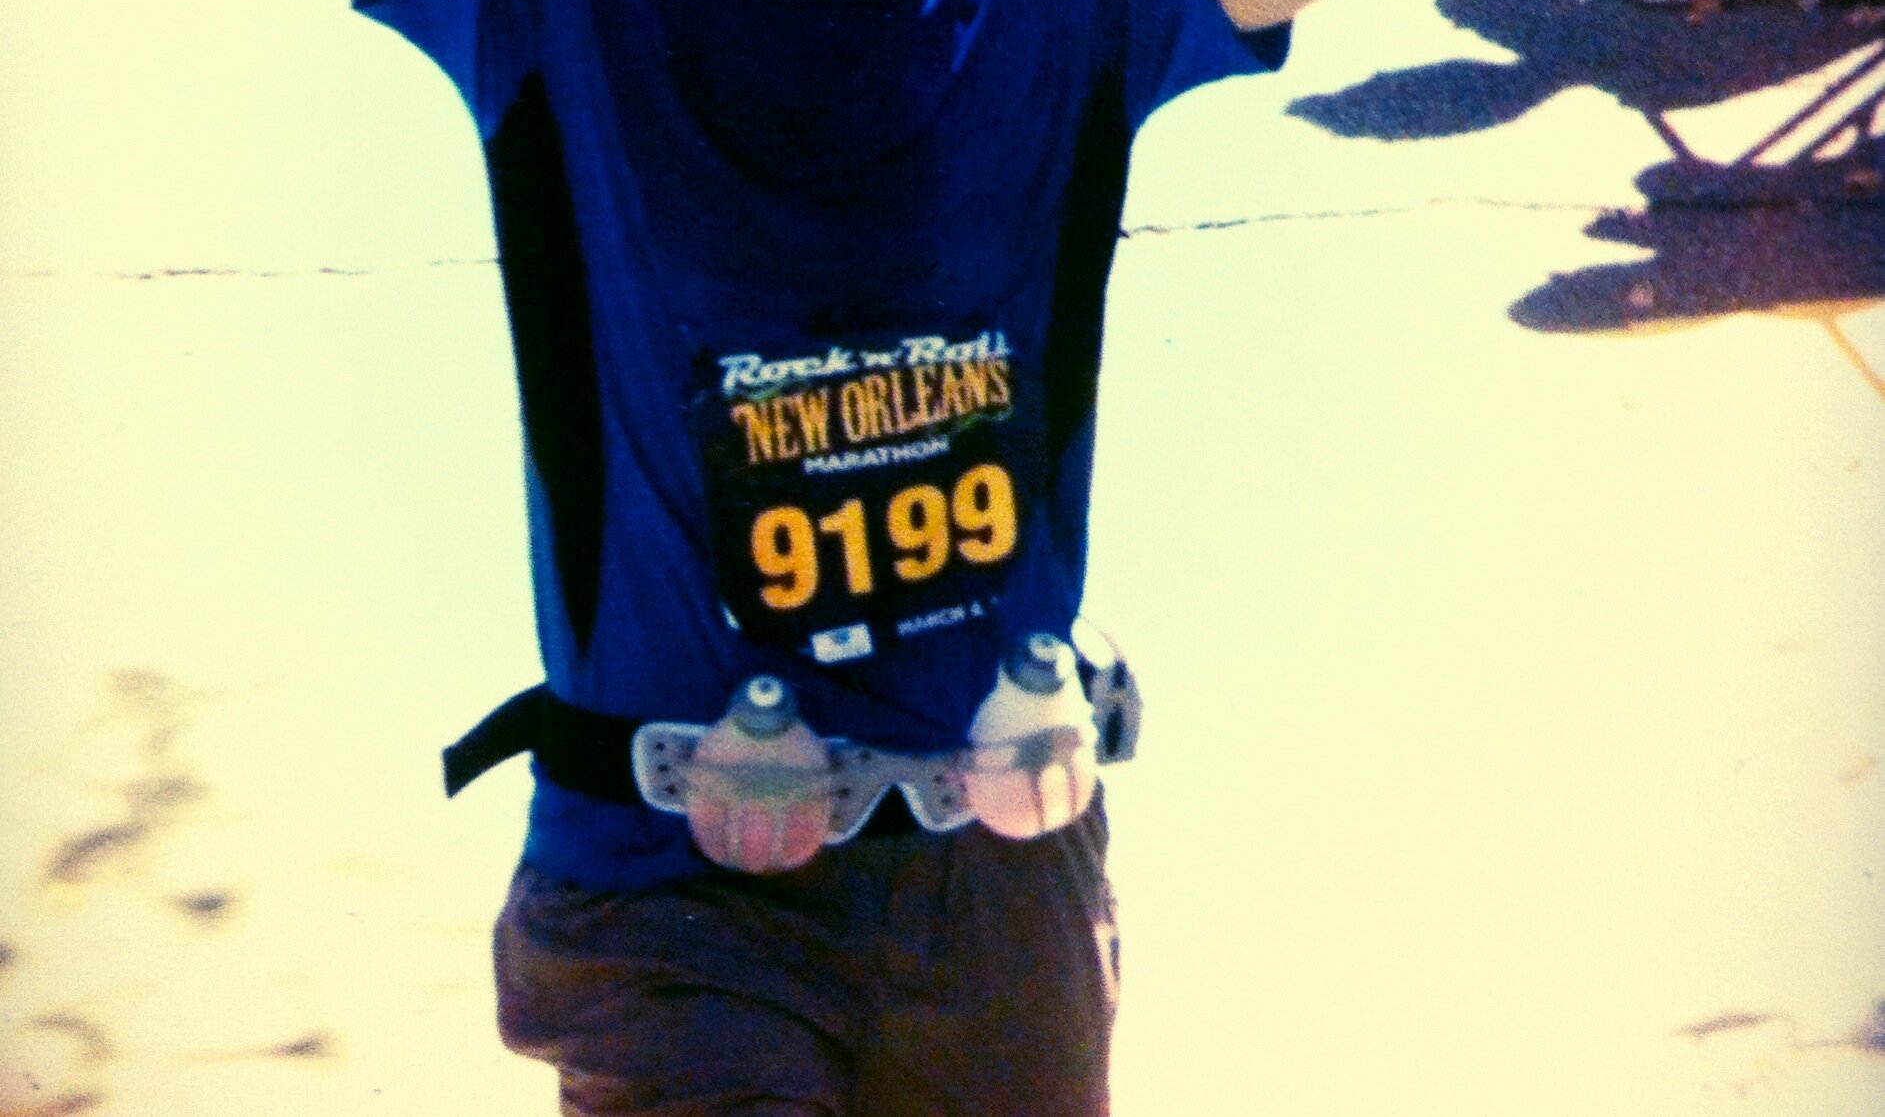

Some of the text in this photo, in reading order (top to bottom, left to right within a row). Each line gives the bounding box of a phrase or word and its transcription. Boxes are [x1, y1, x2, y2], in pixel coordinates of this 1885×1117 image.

[718, 347, 858, 396] Rock
[901, 331, 1012, 366] Roll
[730, 359, 1009, 464] NEW ORLEANS
[803, 434, 950, 475] MARATHON
[751, 463, 1018, 610] 9199
